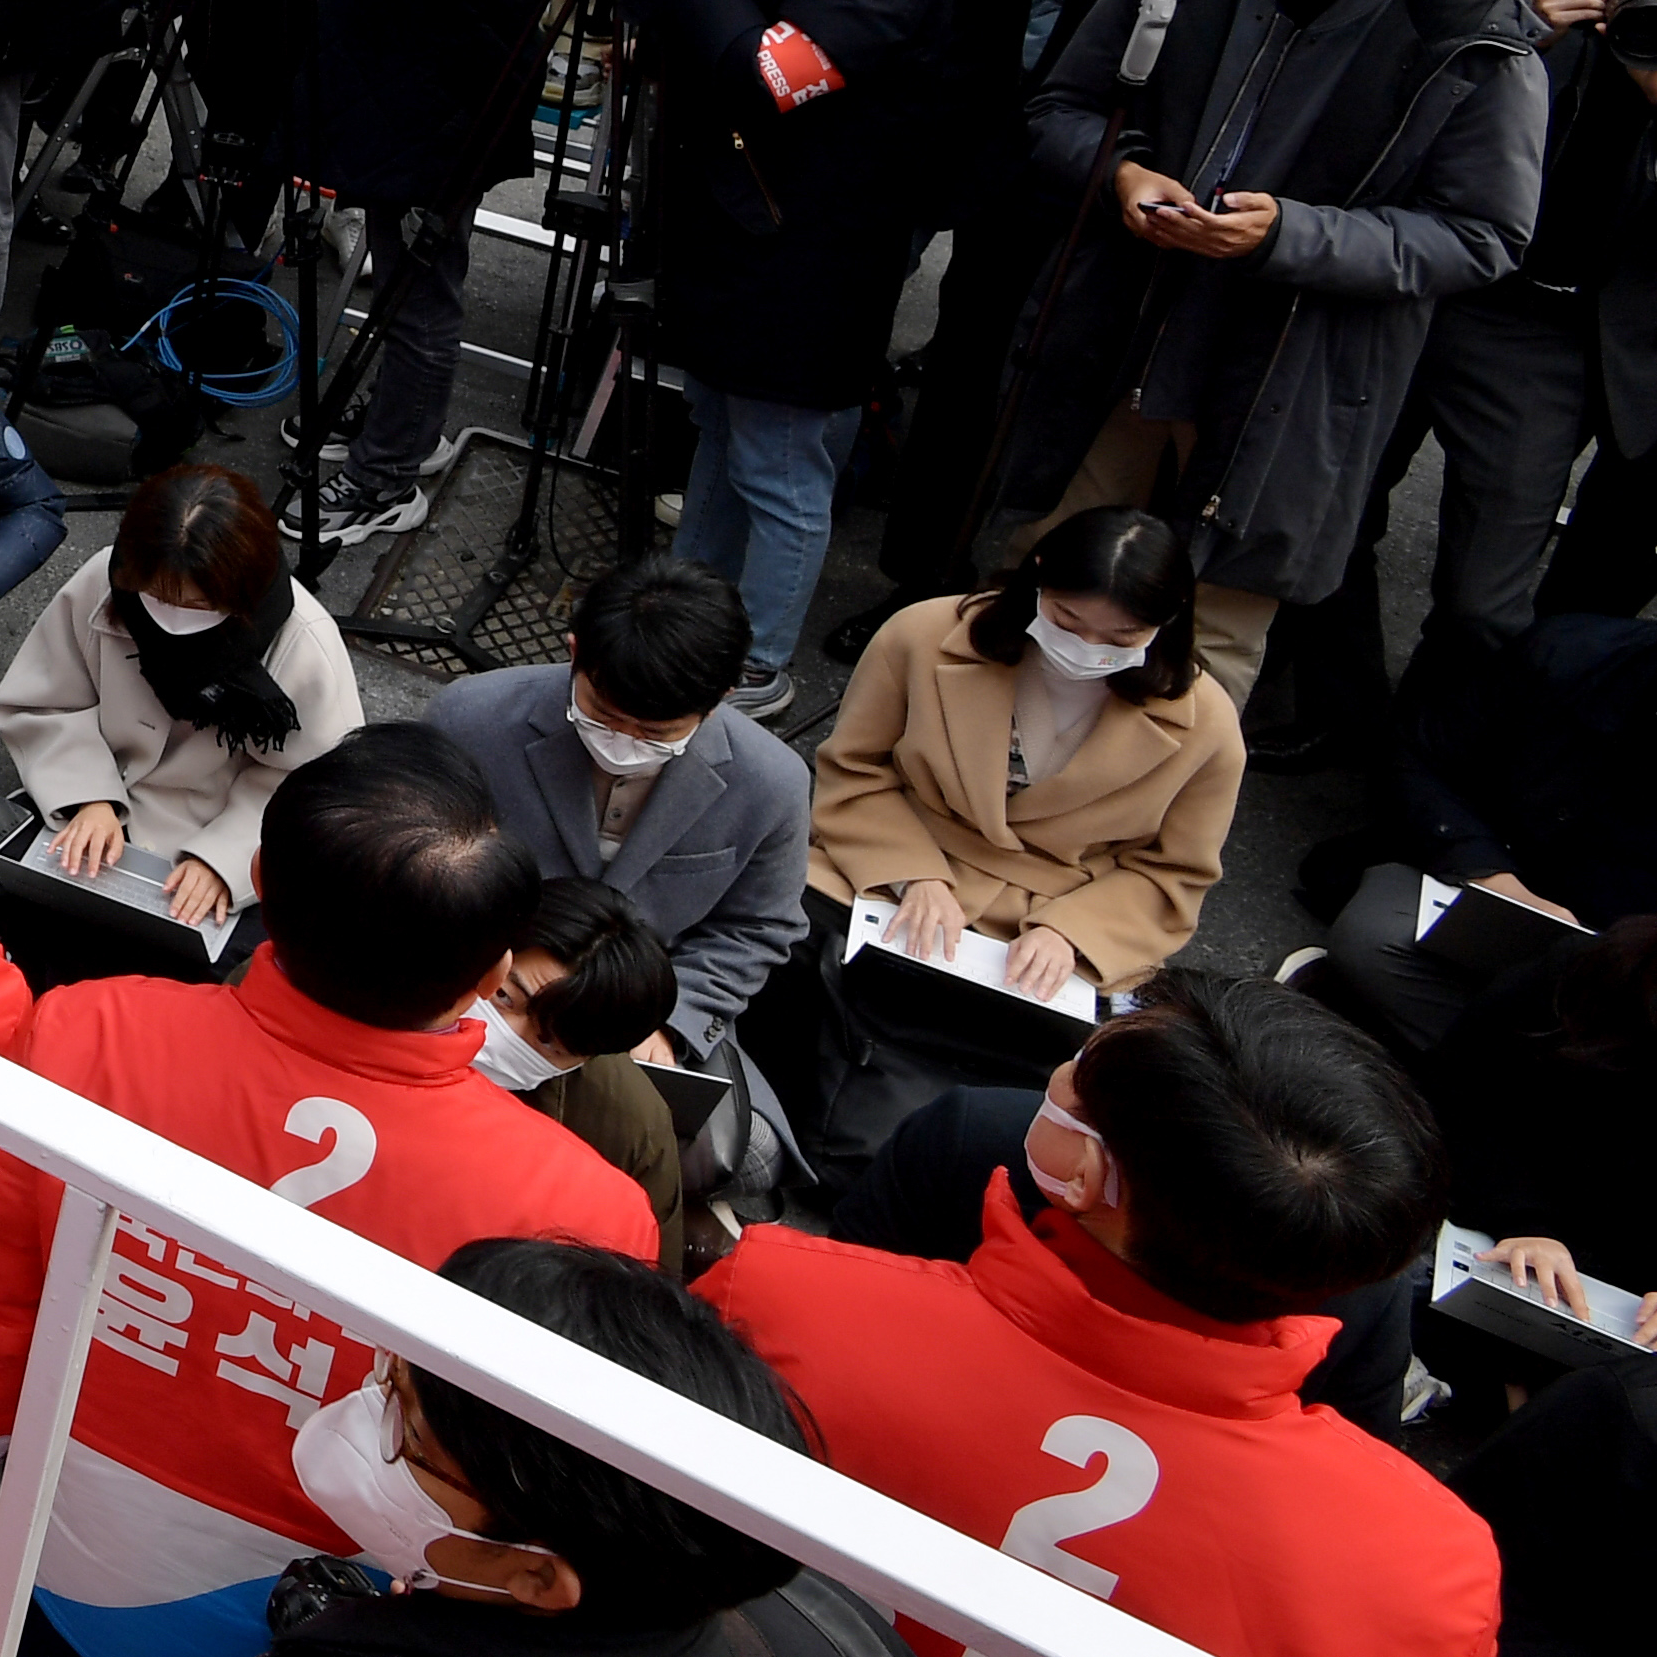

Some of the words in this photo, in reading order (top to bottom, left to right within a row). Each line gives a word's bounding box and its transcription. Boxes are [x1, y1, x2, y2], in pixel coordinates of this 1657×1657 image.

[756, 49, 791, 97] PRESS
[269, 1096, 378, 1210] 2
[89, 1252, 335, 1430] 윤석
[999, 1413, 1161, 1601] 2
